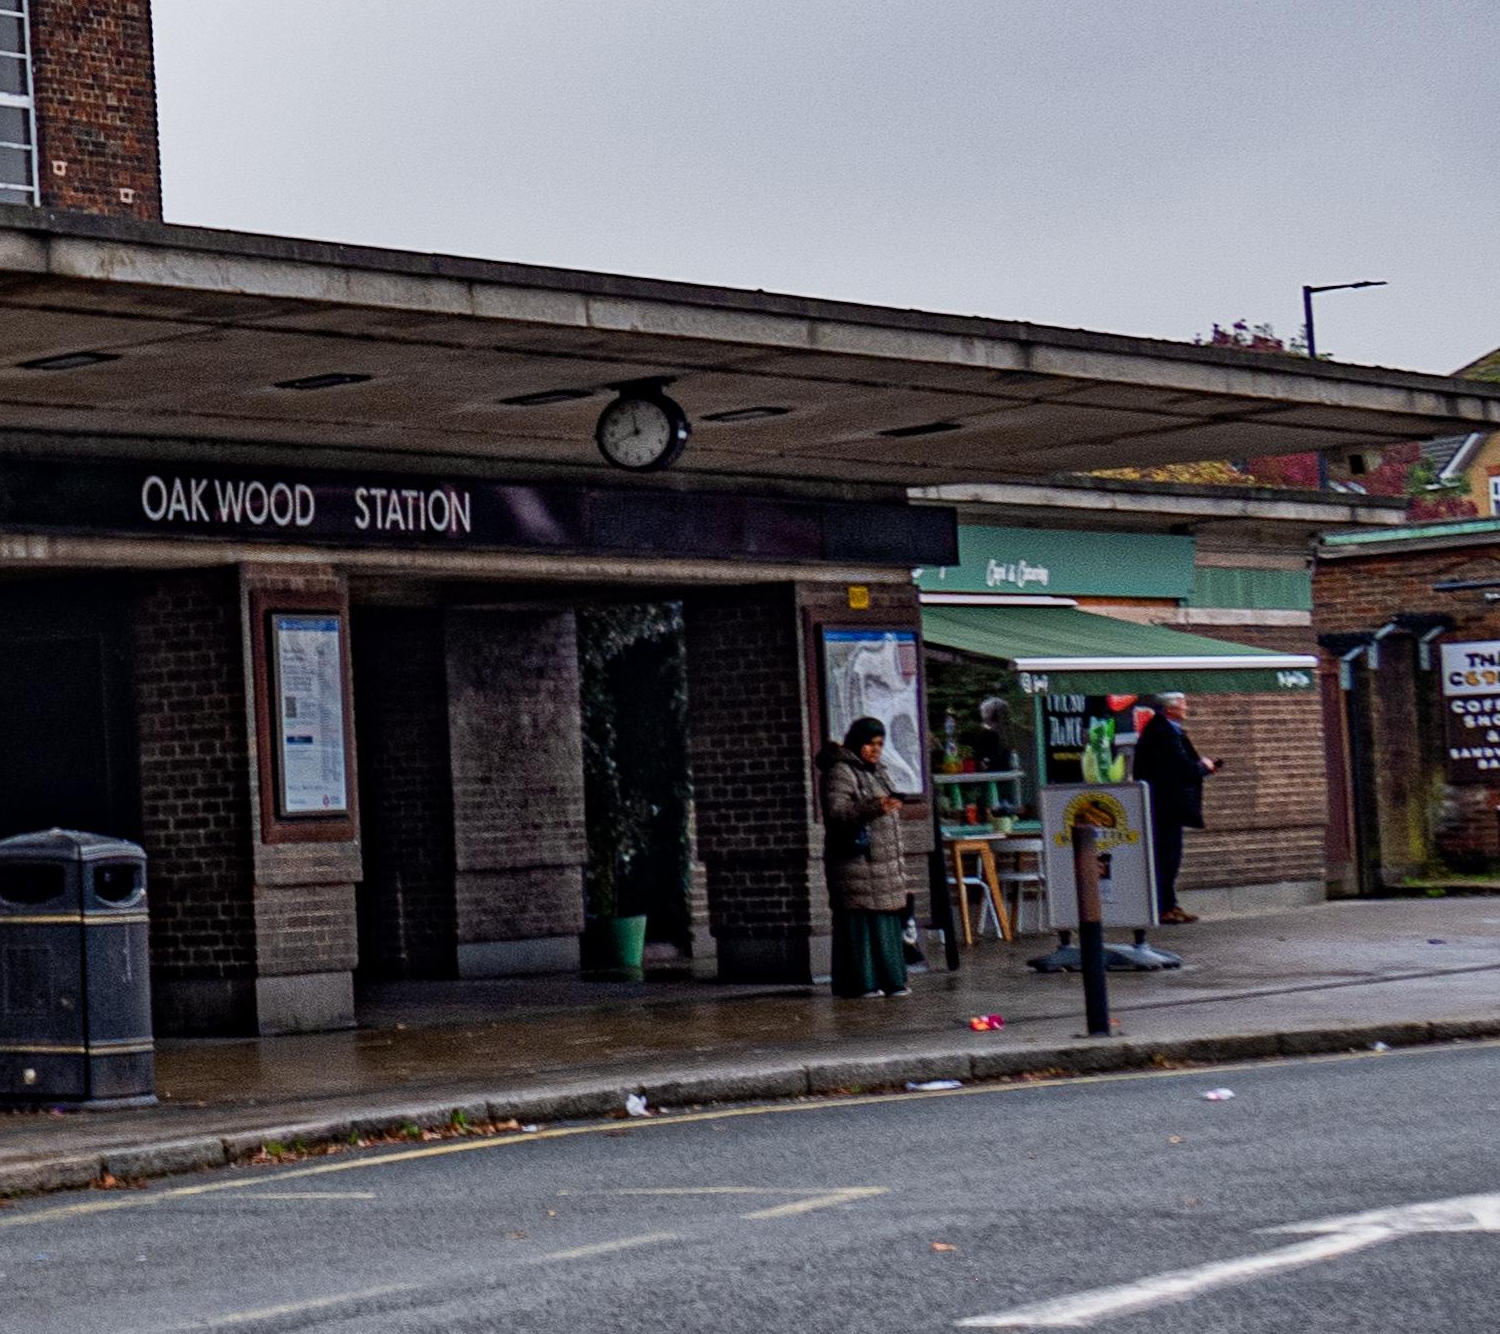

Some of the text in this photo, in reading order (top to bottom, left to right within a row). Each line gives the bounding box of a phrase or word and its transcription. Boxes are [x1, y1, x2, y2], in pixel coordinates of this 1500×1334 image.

[140, 475, 471, 533] OAKWOOD STATION
[1465, 652, 1500, 667] TH
